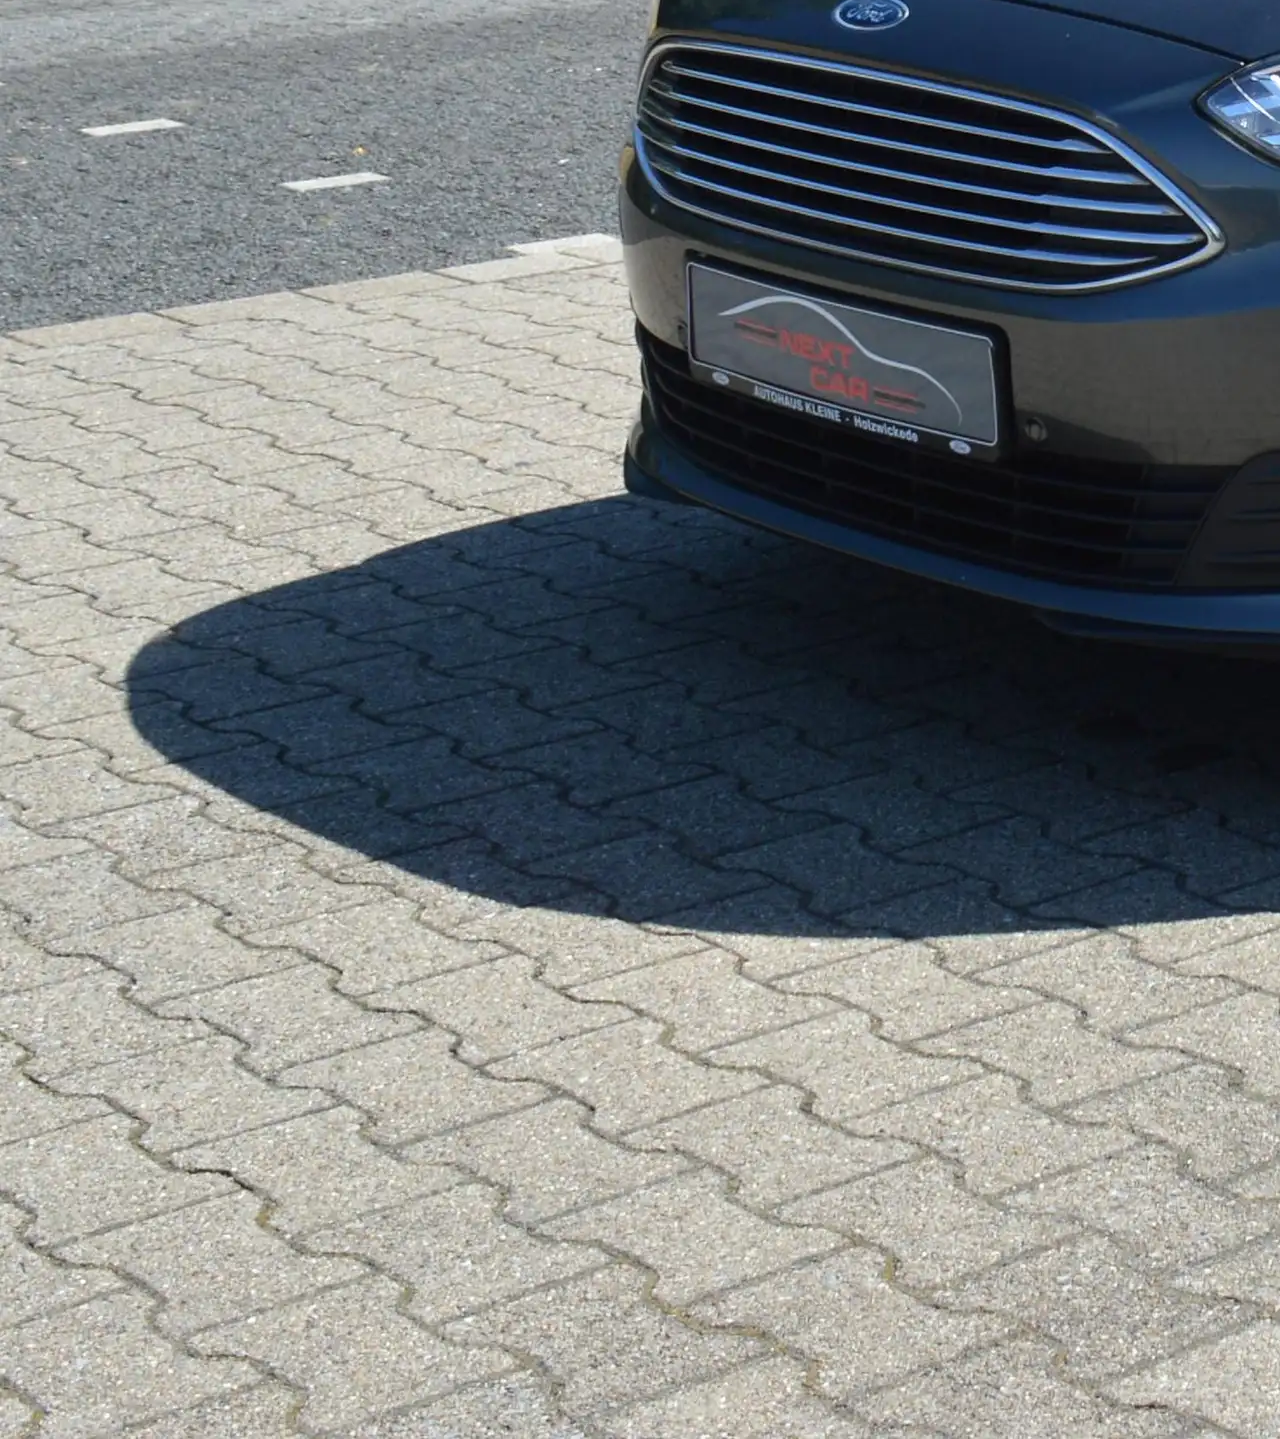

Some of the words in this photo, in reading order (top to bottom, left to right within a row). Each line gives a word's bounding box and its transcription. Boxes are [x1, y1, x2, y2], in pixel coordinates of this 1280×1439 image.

[780, 329, 854, 368] NEXT
[810, 366, 868, 404] CAR
[754, 385, 803, 410] AUTOHAUS
[805, 403, 842, 422] KLEINE
[853, 415, 919, 443] Holzwickede
